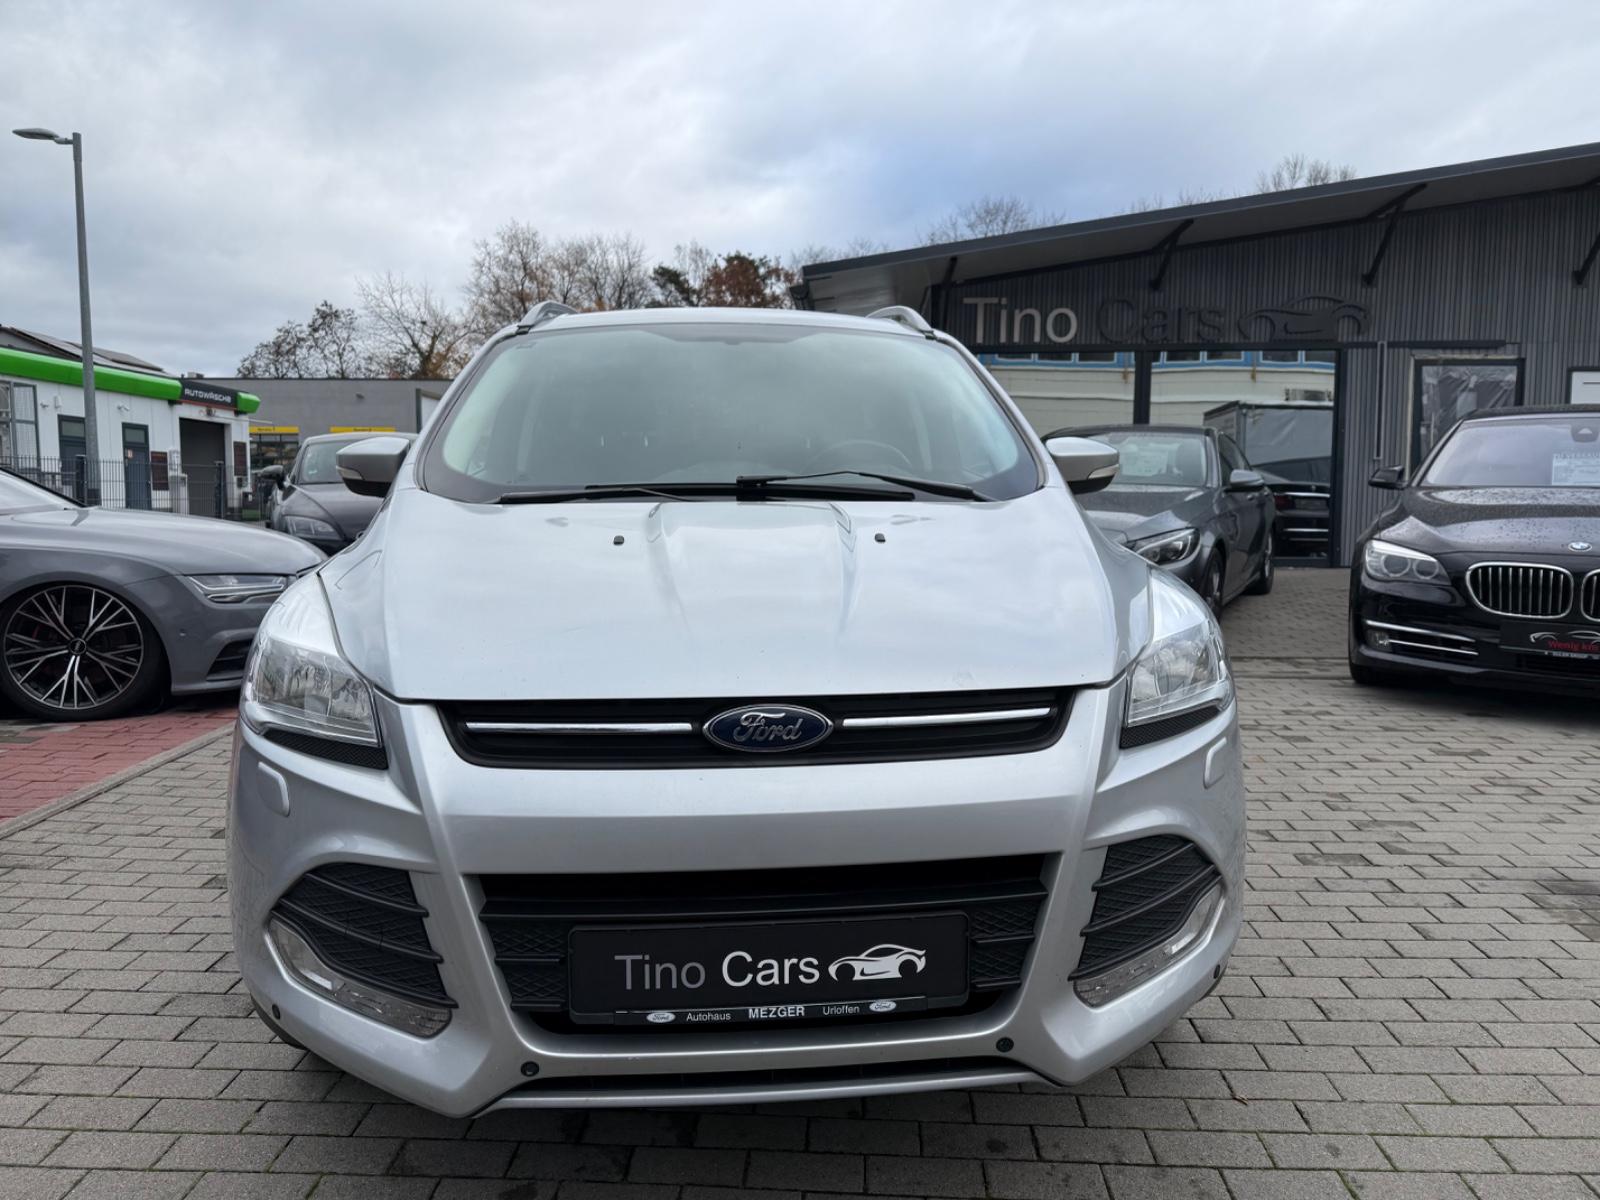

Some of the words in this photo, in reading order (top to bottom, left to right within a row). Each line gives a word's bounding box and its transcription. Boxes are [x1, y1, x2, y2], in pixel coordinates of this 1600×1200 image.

[963, 297, 1078, 343] Tino
[1098, 298, 1225, 343] Cars
[733, 711, 804, 742] Ford
[614, 954, 706, 990] Tino
[721, 950, 820, 987] Cars
[685, 1012, 732, 1022] Autohaus
[748, 1006, 806, 1019] MEZGER
[822, 1004, 860, 1016] Urloffen
